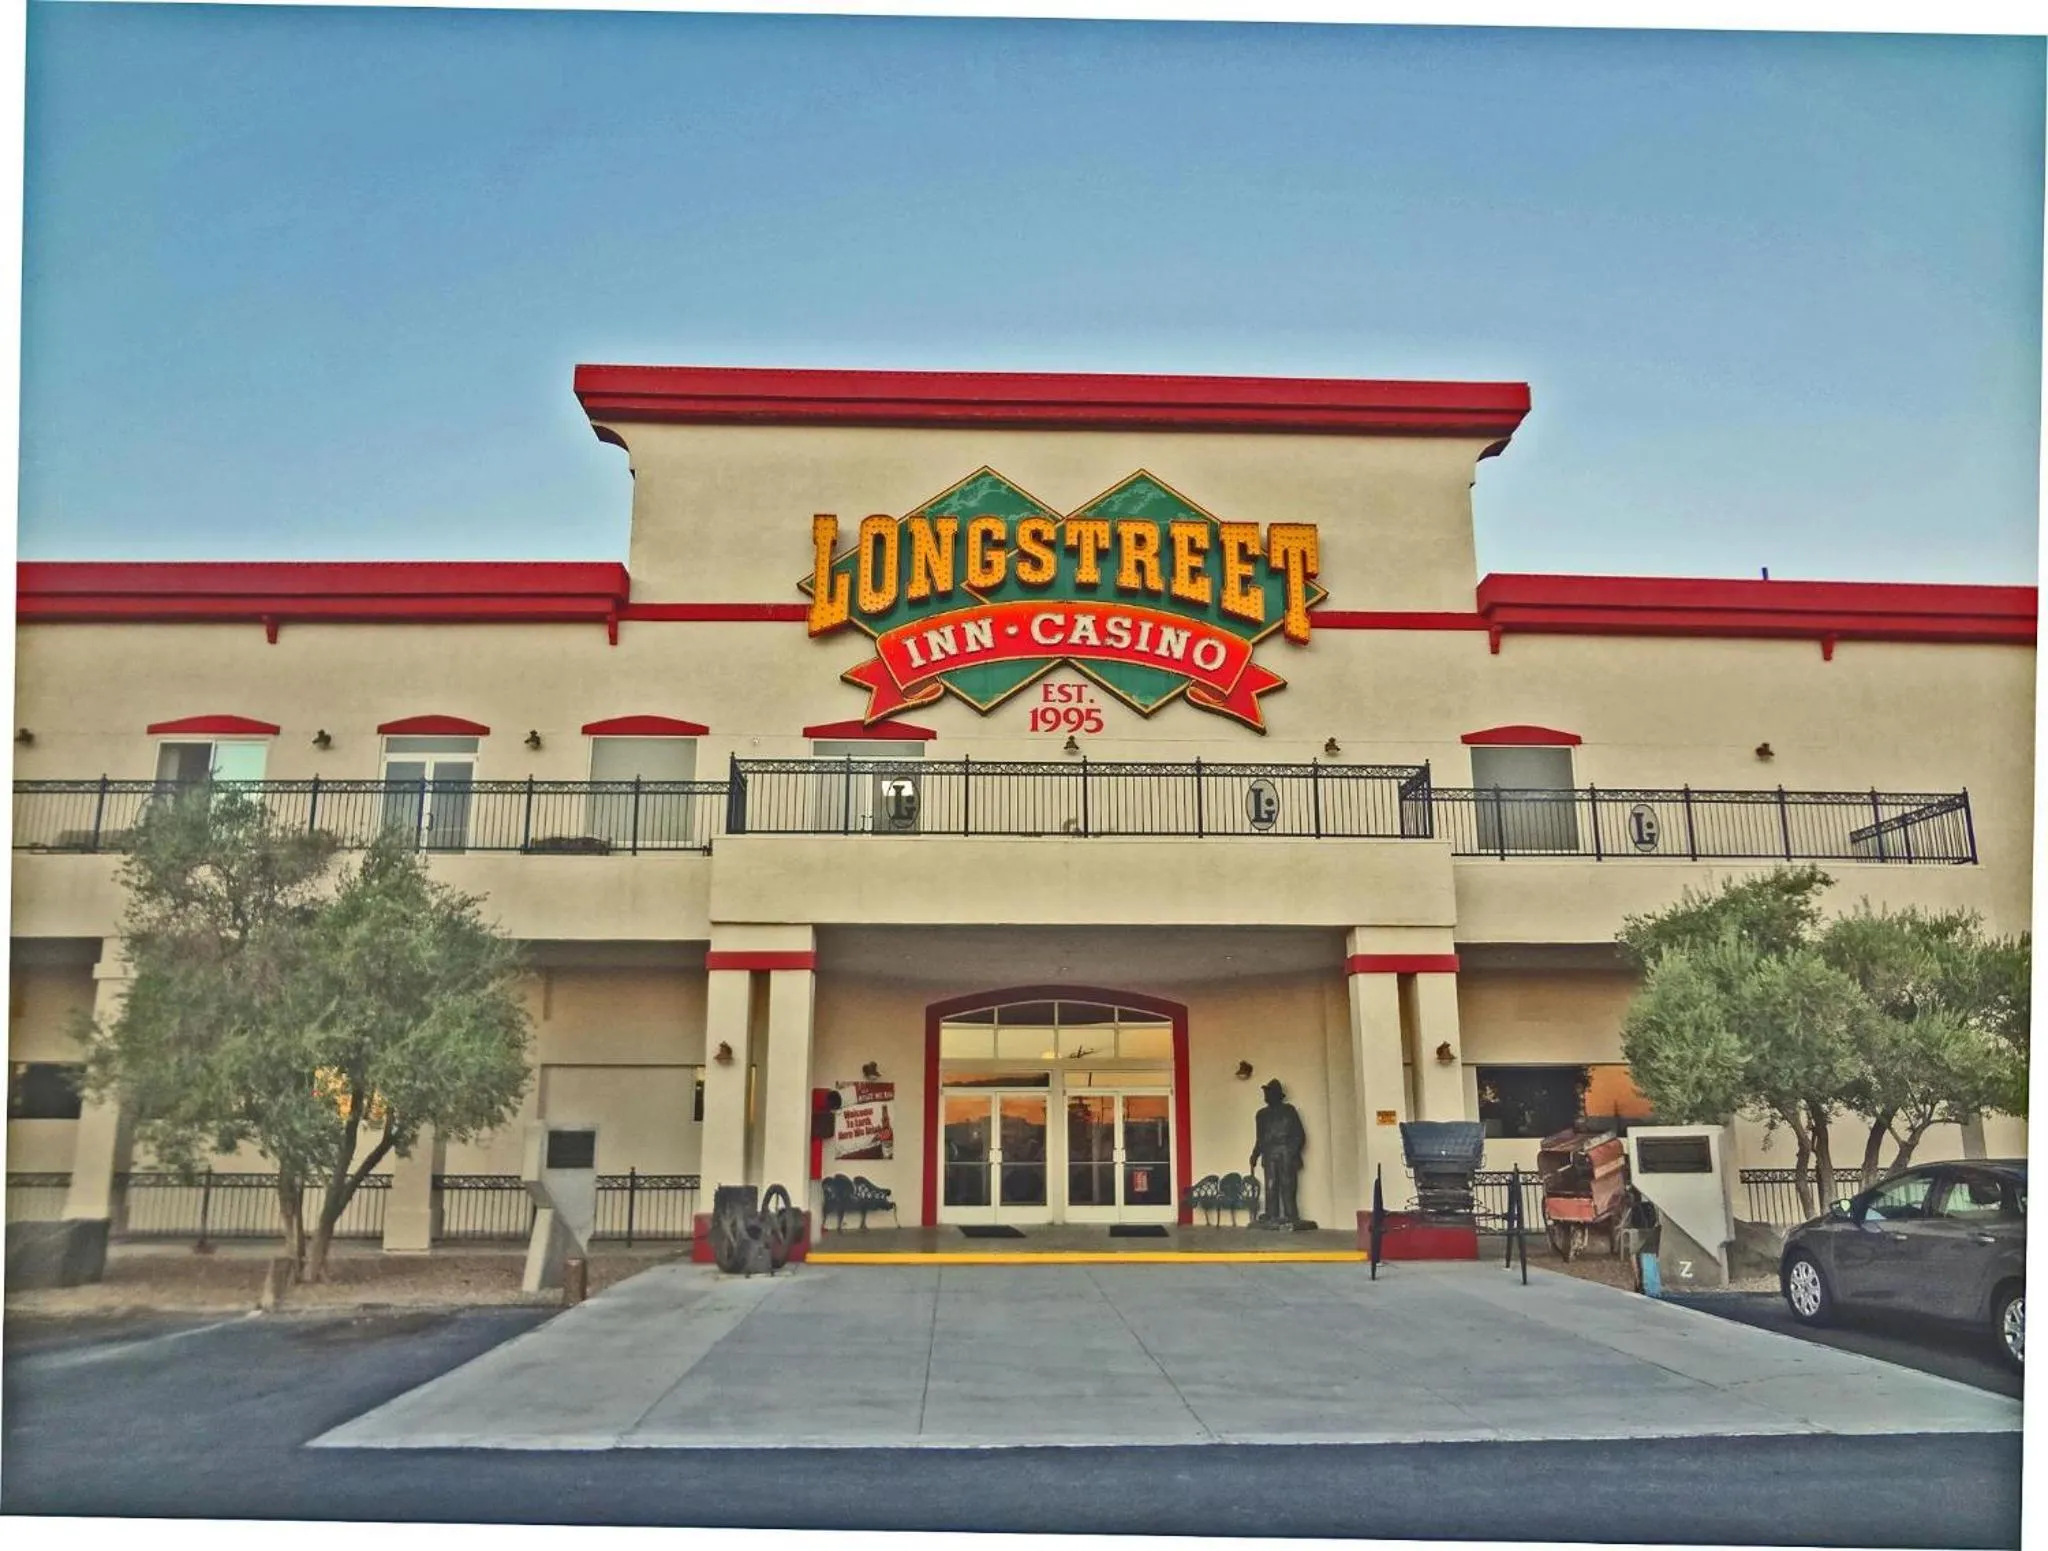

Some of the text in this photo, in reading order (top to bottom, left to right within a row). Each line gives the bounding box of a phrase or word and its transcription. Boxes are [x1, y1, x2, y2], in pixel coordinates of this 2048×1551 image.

[807, 514, 1320, 646] LONGSTREET
[902, 613, 1227, 672] INN CASINO
[1042, 683, 1094, 704] EST.
[1028, 707, 1104, 734] 1995
